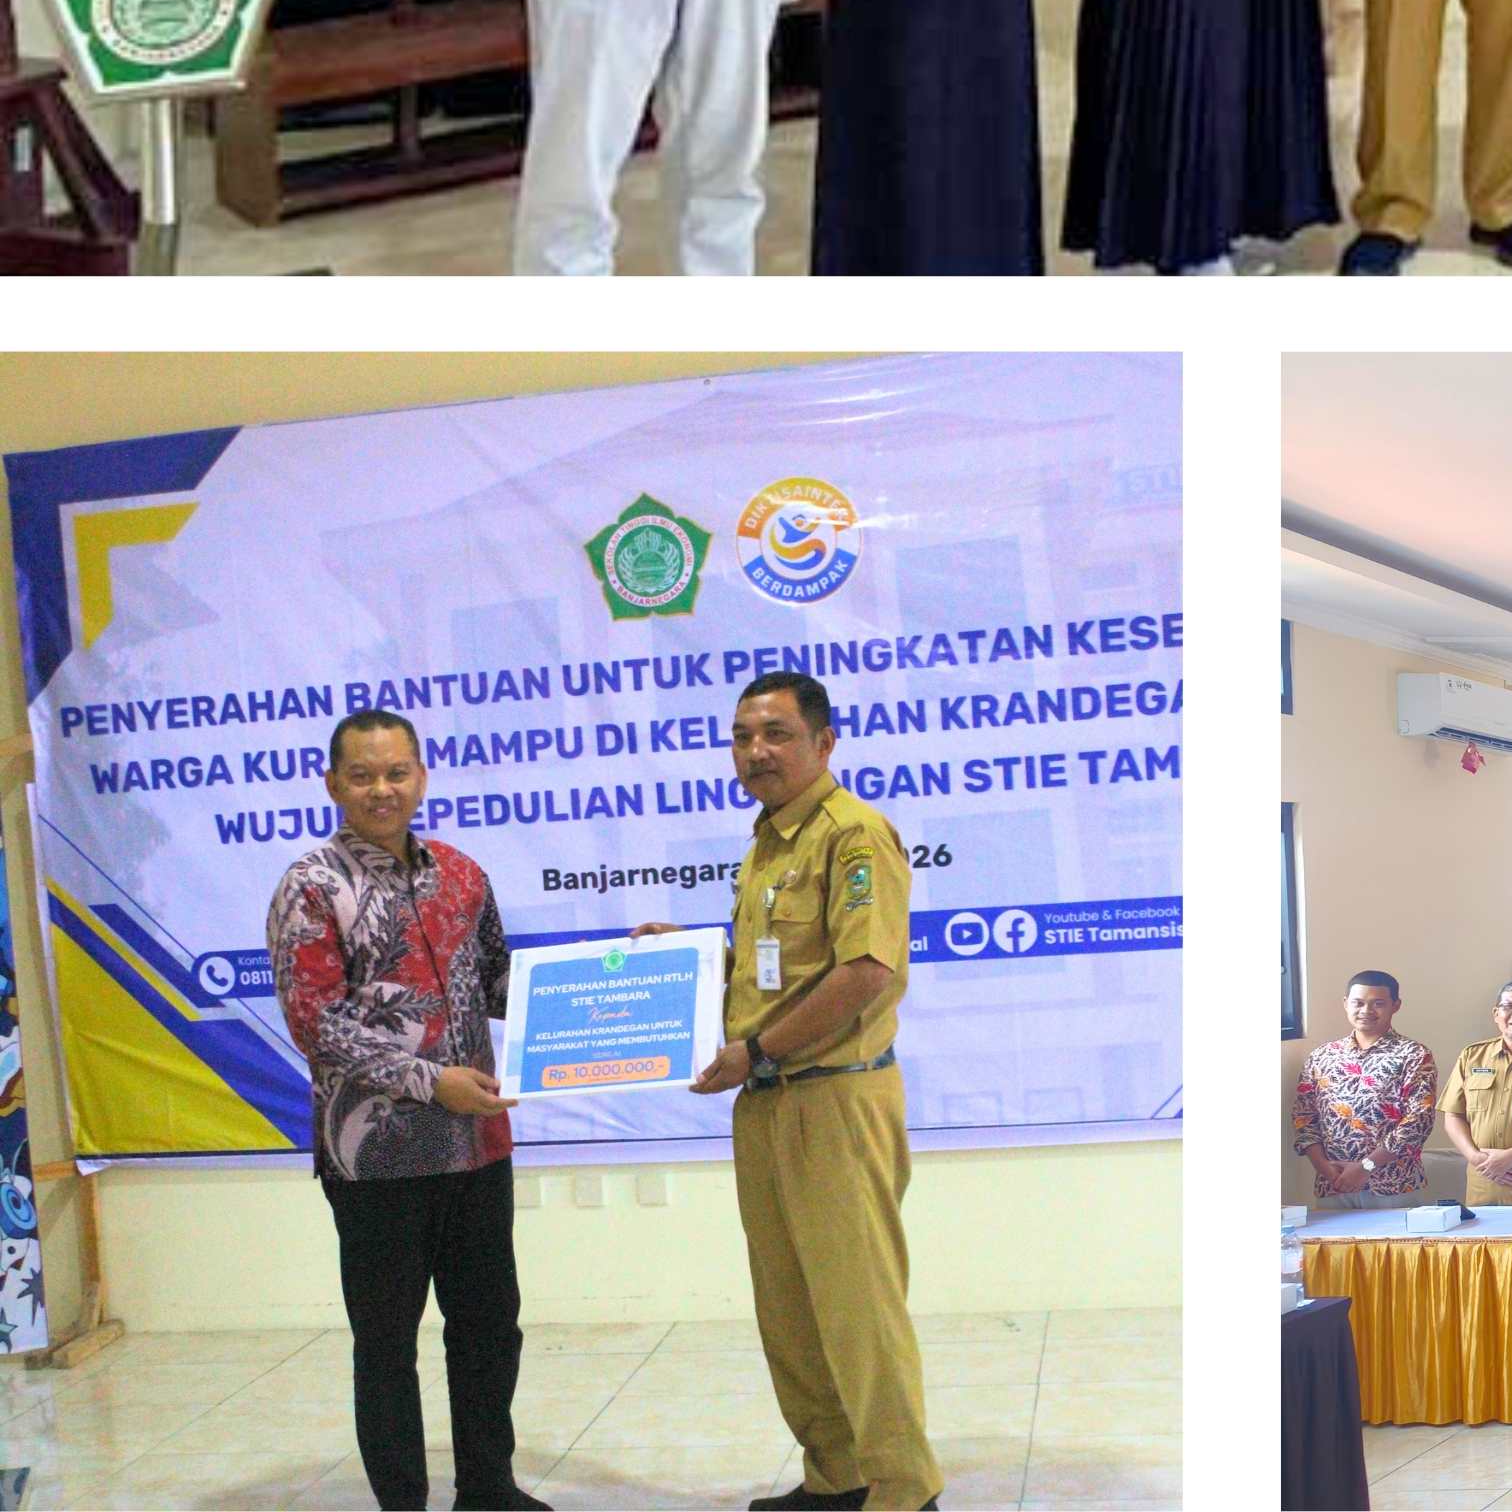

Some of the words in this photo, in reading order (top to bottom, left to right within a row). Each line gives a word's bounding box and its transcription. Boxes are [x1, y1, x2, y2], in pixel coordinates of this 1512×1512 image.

[751, 558, 849, 599] BERDAMPAK
[61, 686, 335, 738] PENYERAHAN
[346, 666, 550, 715] BANTUAN
[563, 651, 712, 697] UNTUK
[724, 623, 1053, 685] PENINGKATAN
[91, 754, 234, 795] WARGA
[428, 727, 582, 770] MAMPU
[597, 722, 640, 758] DI
[216, 806, 342, 845] WUJU
[964, 751, 1066, 793] STIE
[1045, 911, 1099, 924] Youtube
[1102, 909, 1111, 921] &
[1115, 905, 1181, 921] Facebook
[1045, 928, 1083, 945] STIE
